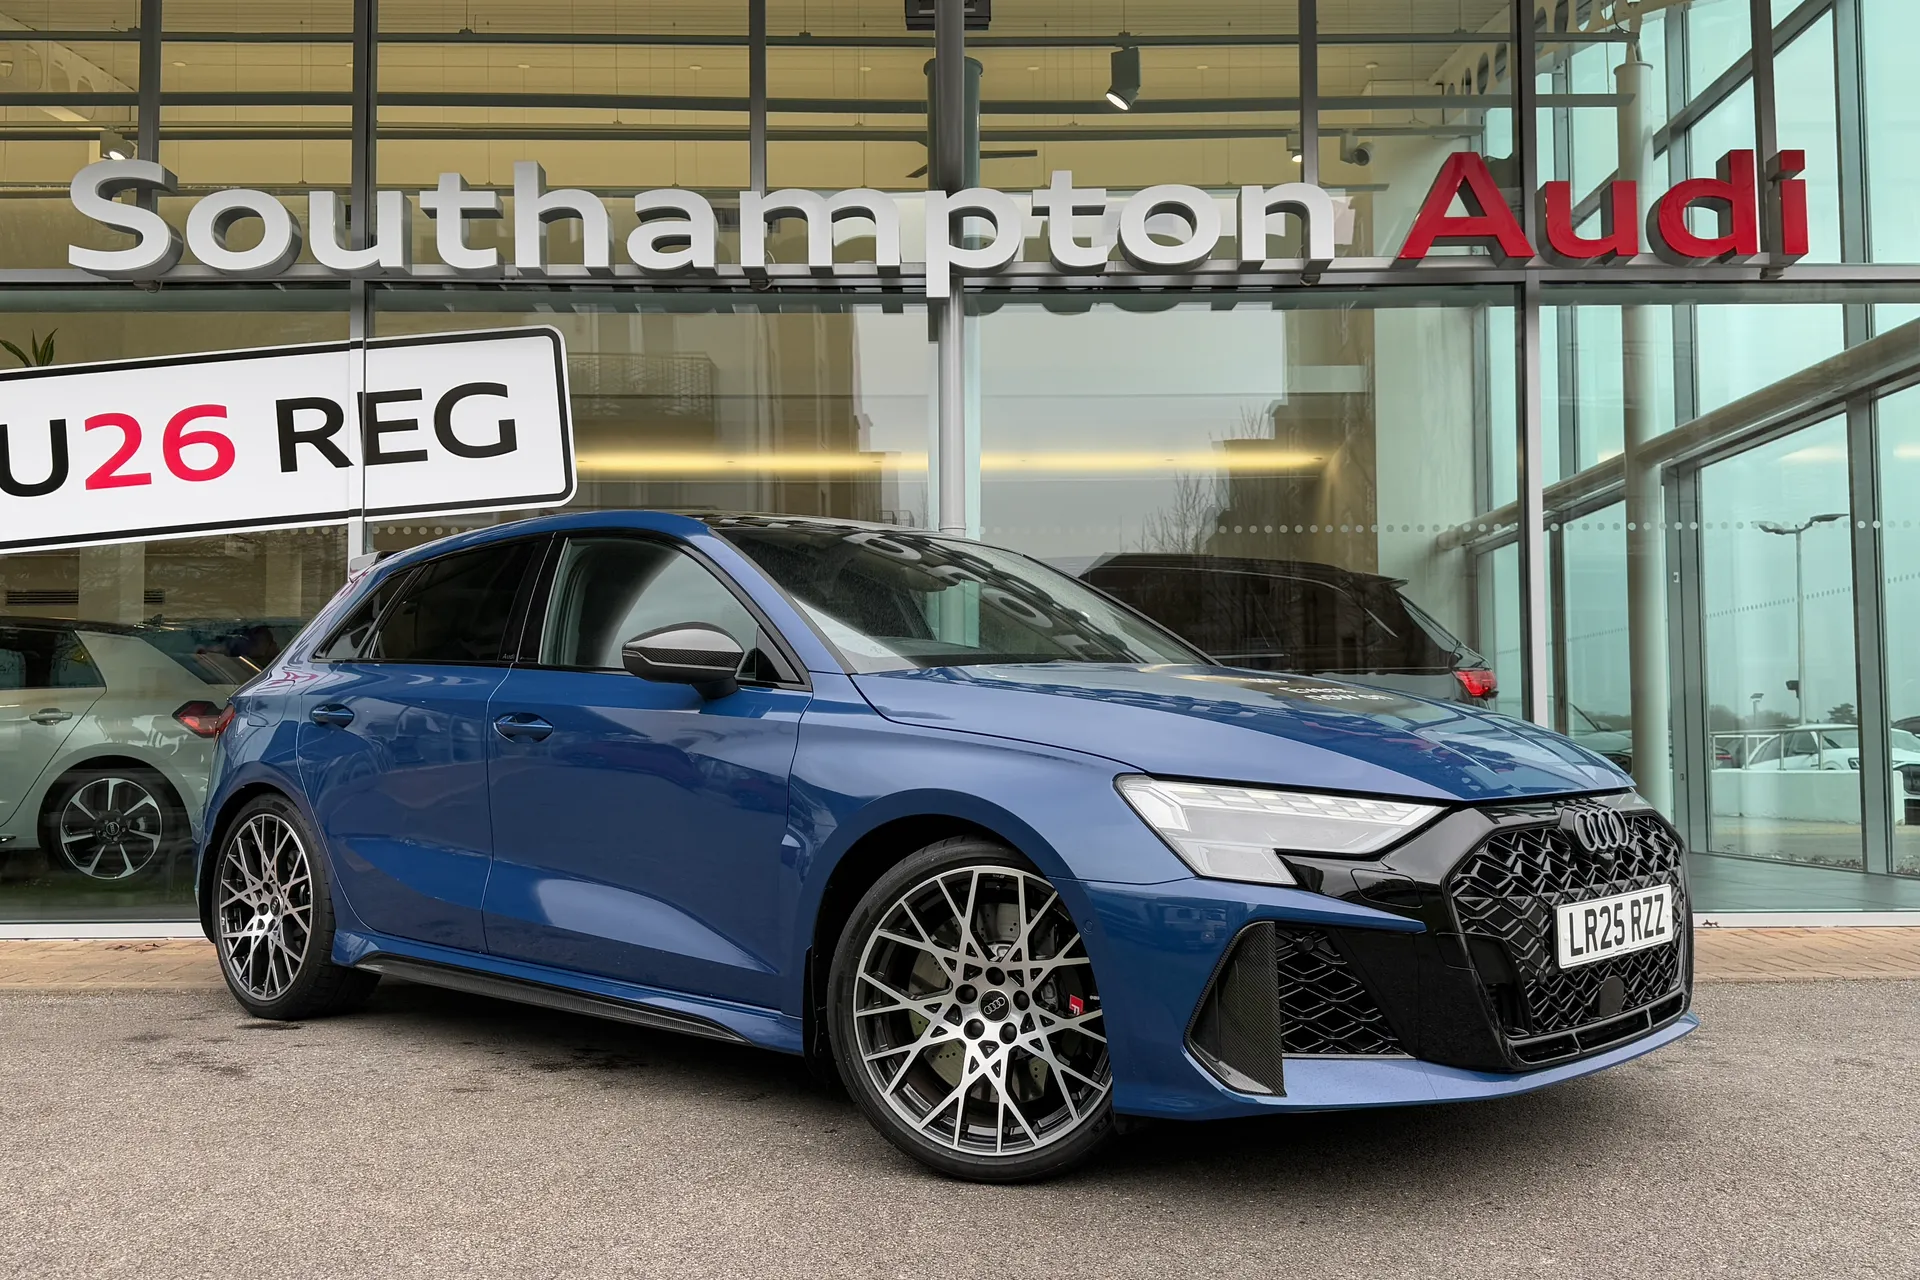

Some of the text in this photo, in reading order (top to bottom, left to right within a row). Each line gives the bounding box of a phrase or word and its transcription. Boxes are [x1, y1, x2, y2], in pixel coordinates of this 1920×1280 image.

[68, 149, 1809, 299] Southampton Audi
[0, 381, 518, 498] U26 REG
[1568, 893, 1666, 958] LR25 RZZ
